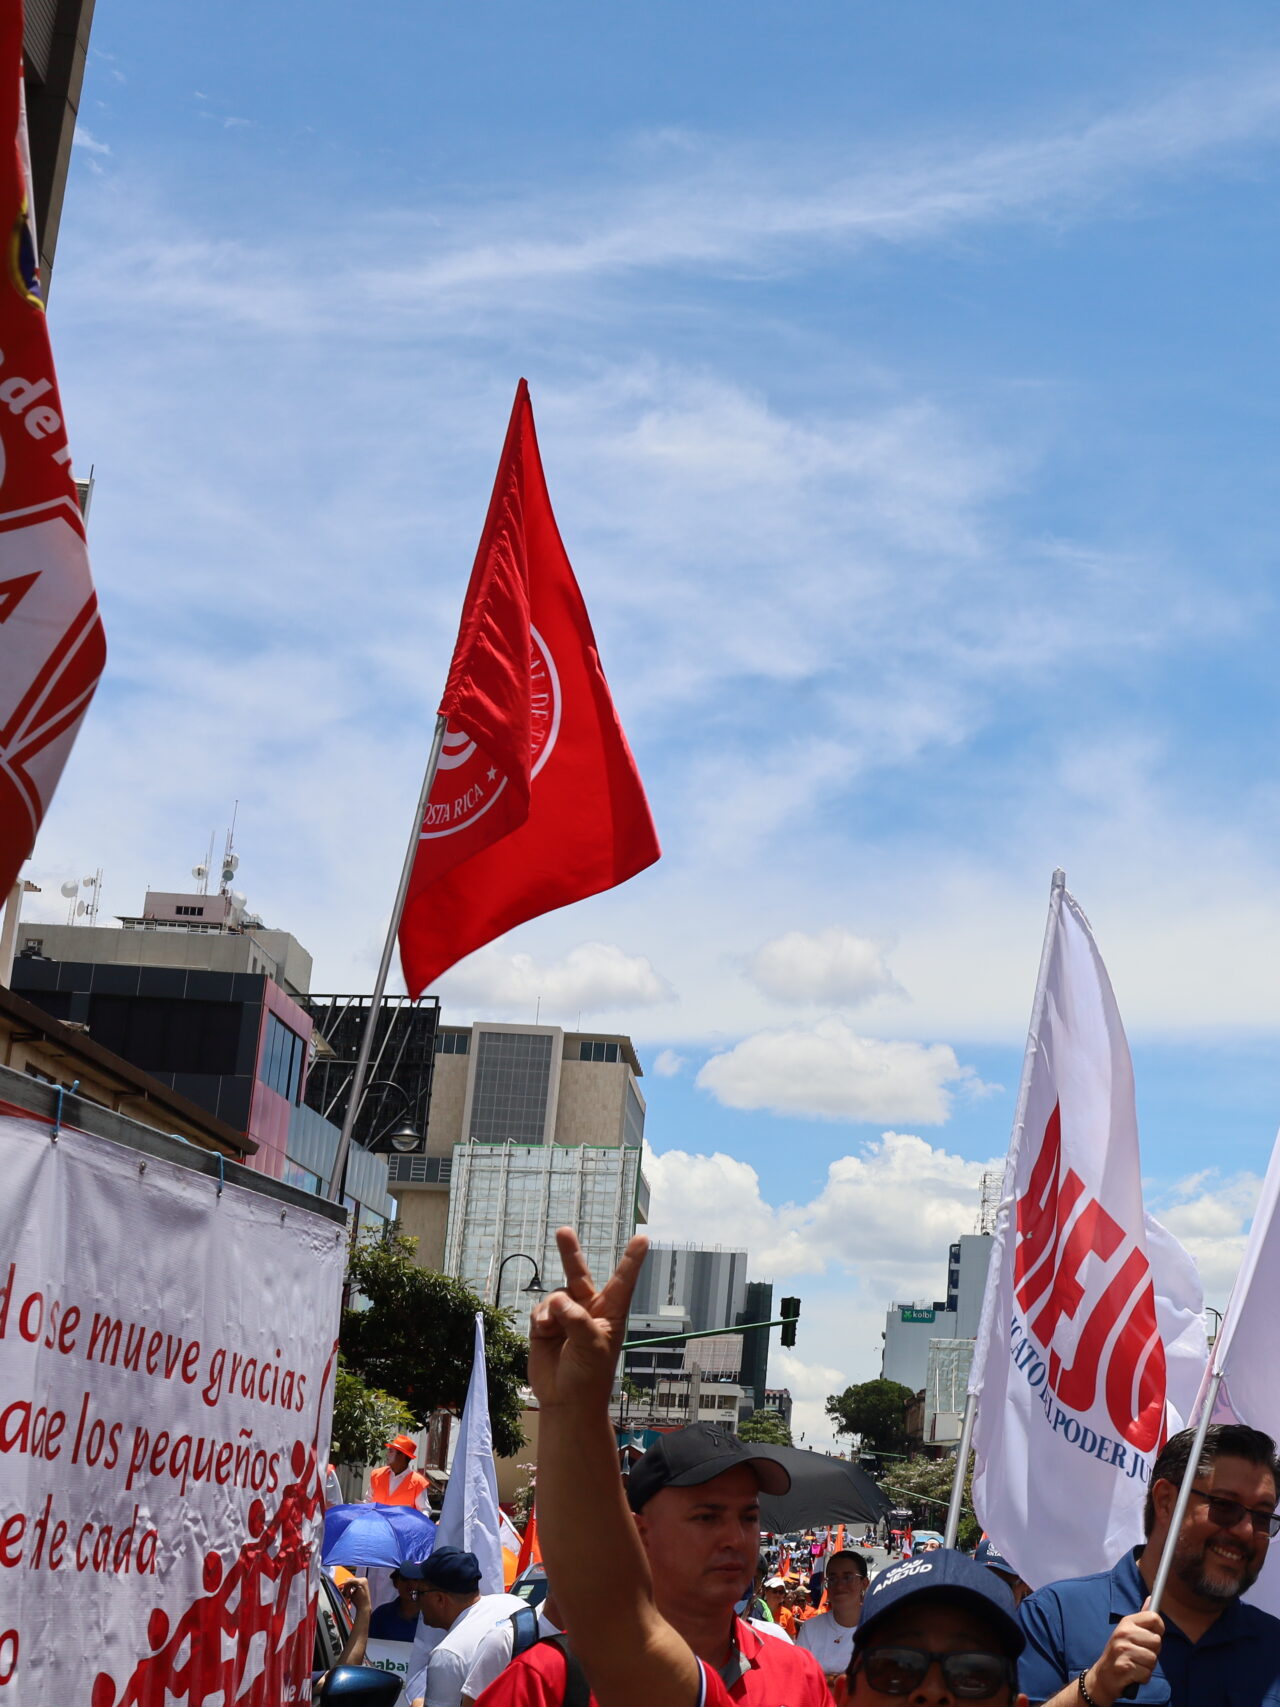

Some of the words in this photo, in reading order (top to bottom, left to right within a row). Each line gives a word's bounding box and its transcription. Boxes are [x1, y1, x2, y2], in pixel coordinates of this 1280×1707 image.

[454, 784, 484, 819] RICA
[87, 1312, 201, 1384] mueve
[202, 1347, 307, 1413] gracias
[71, 1391, 123, 1469] los
[125, 1428, 281, 1497] pequeños
[1053, 1408, 1128, 1469] PODER
[76, 1504, 158, 1575] cada
[872, 1563, 933, 1596] ANEJUD
